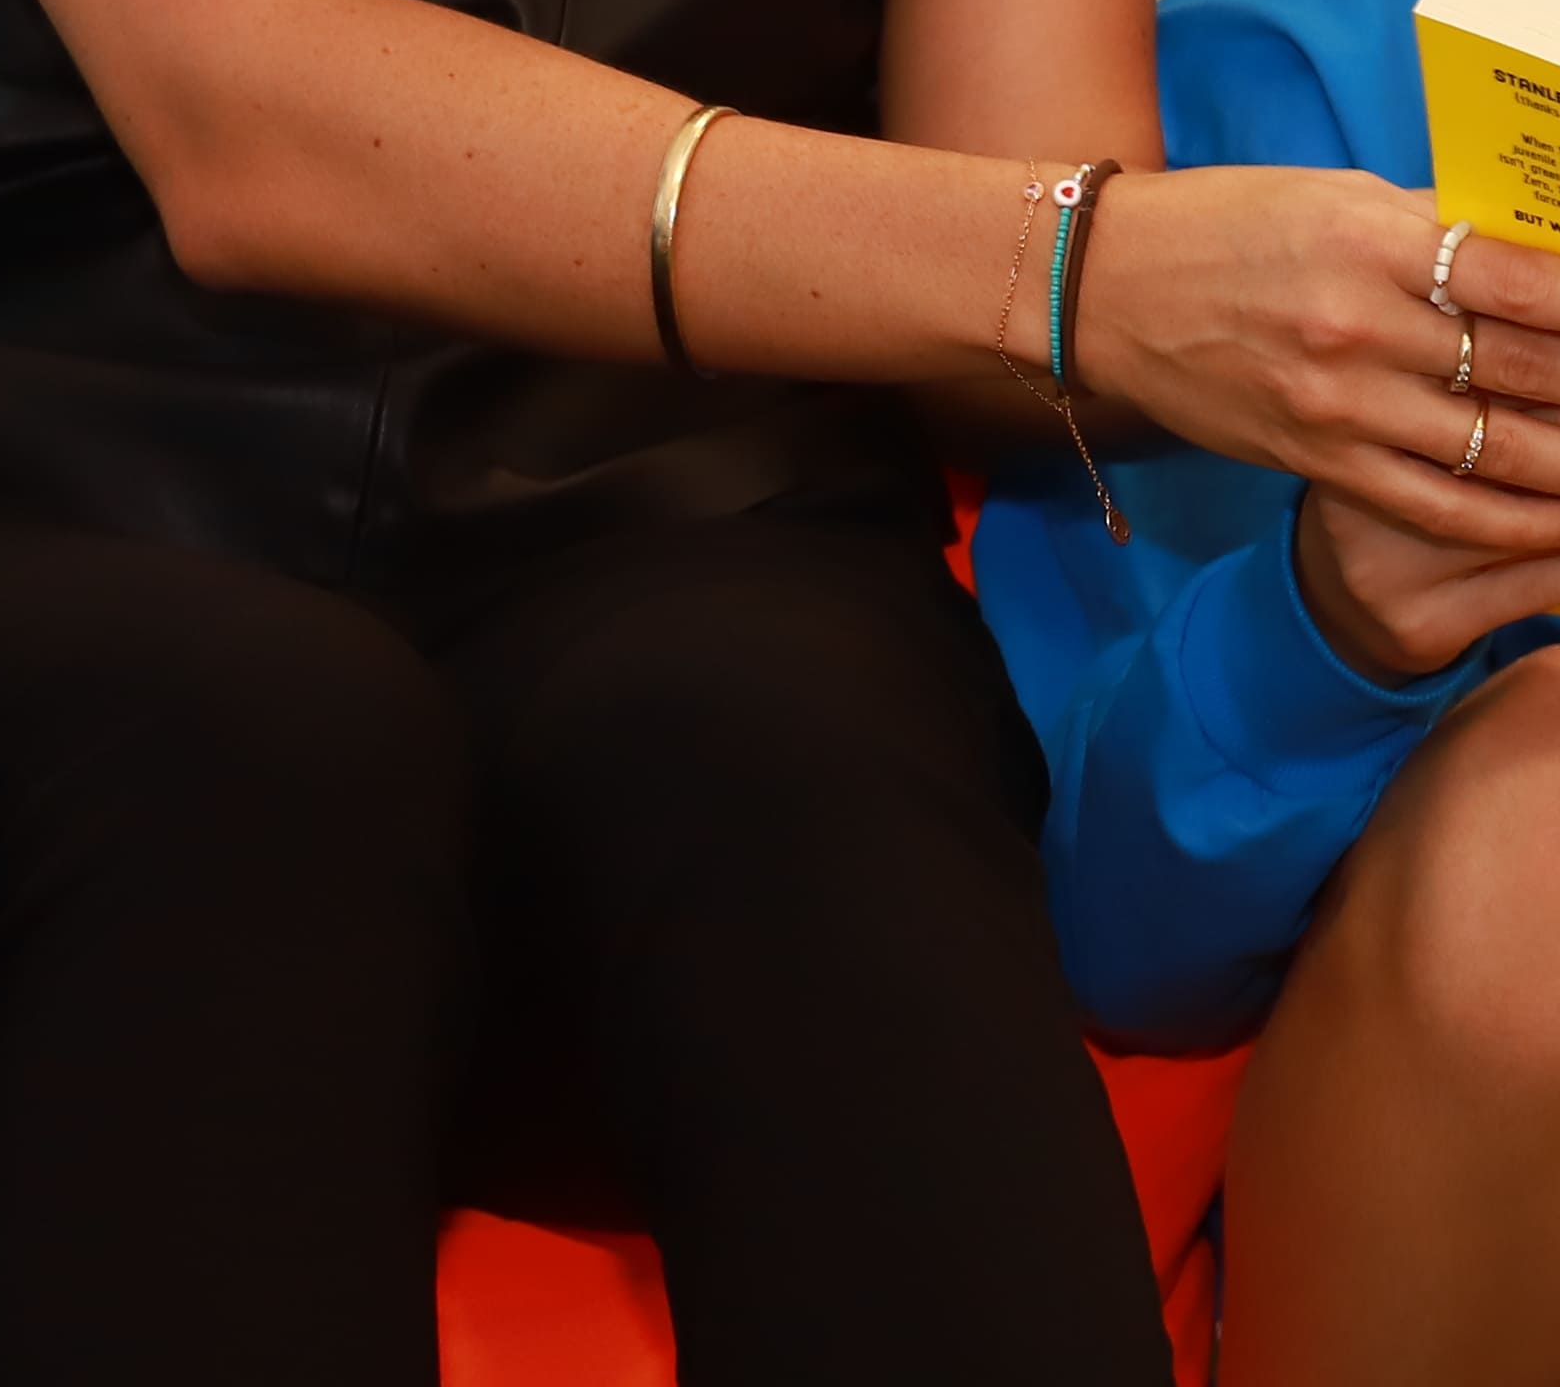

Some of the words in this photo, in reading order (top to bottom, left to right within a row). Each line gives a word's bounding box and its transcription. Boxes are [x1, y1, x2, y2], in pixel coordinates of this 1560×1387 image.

[1521, 132, 1554, 154] When
[1512, 143, 1557, 170] juvenile
[1513, 206, 1545, 229] BUT
